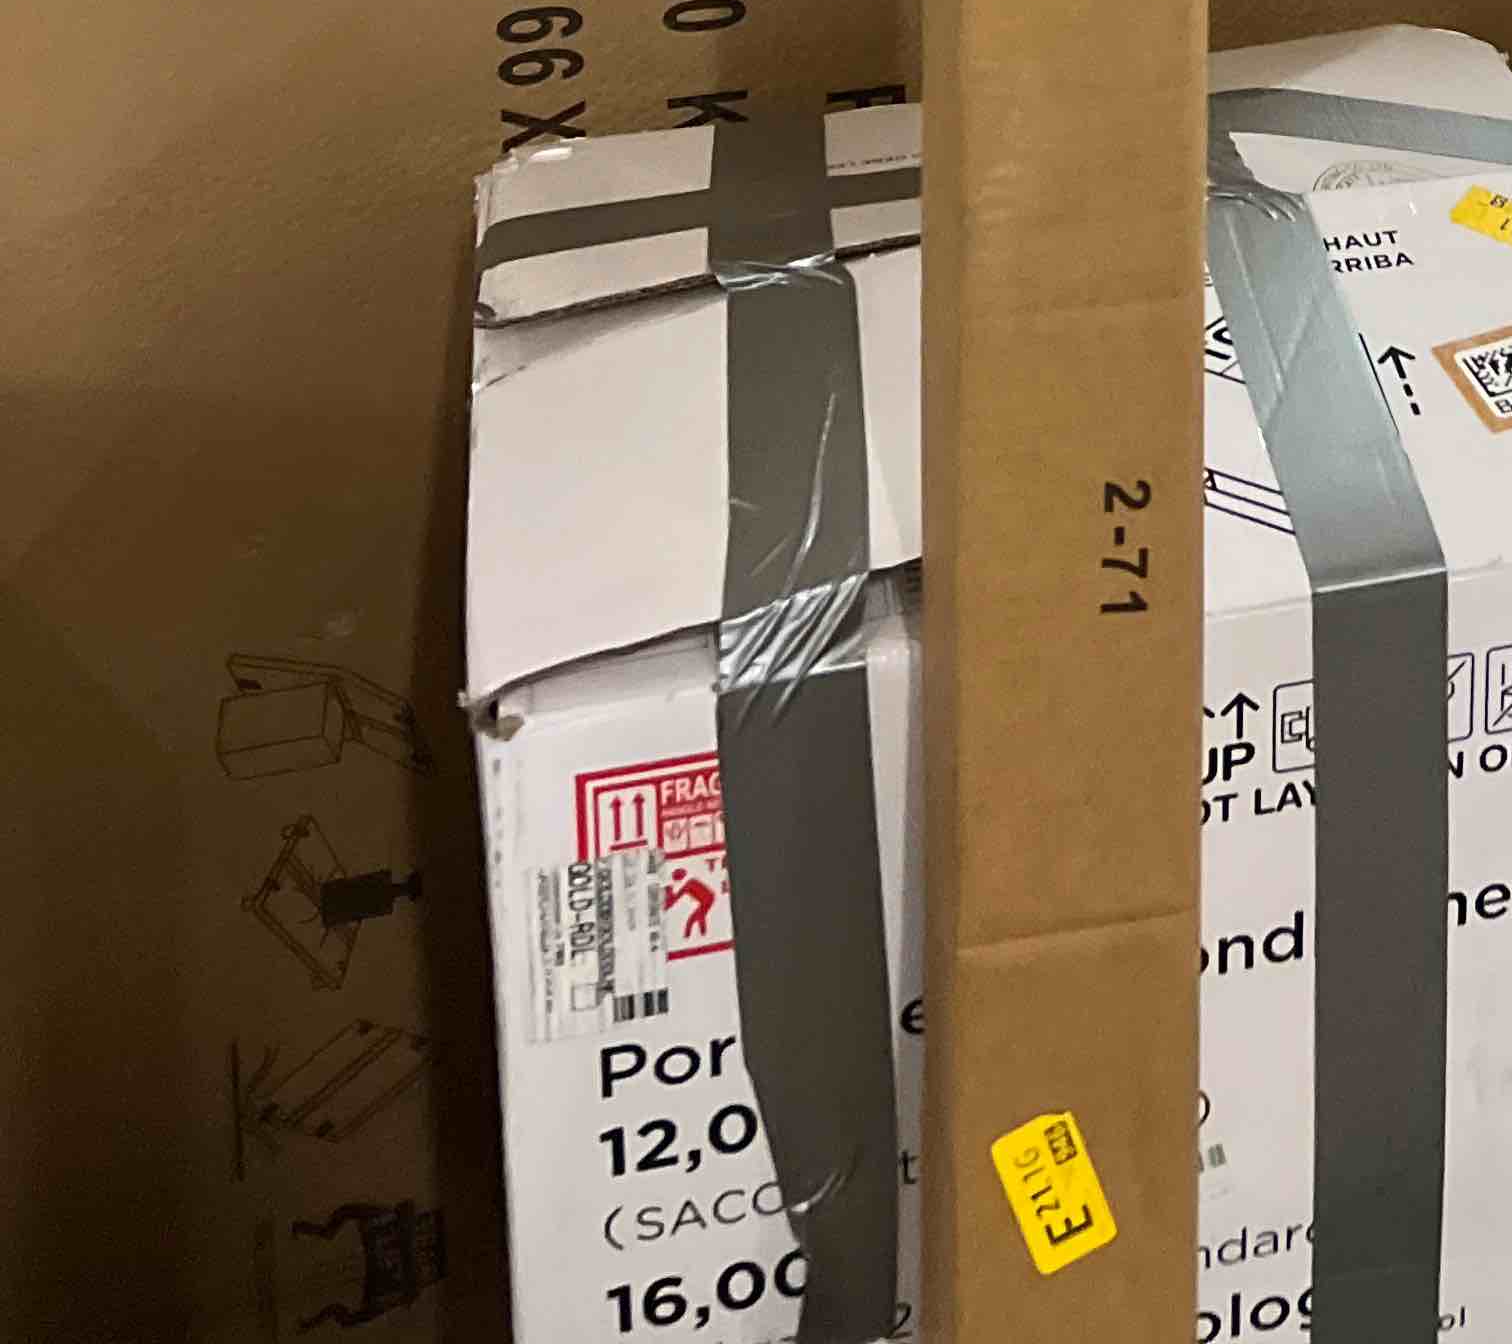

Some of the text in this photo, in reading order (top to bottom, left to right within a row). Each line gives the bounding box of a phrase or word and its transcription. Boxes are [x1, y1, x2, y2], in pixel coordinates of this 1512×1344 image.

[1322, 229, 1399, 253] HAUT
[1330, 251, 1416, 274] RRIBA
[1099, 479, 1153, 615] 2-71
[599, 1104, 758, 1178] 12,0
[603, 1180, 783, 1252] (SACC
[1046, 1200, 1096, 1249] E
